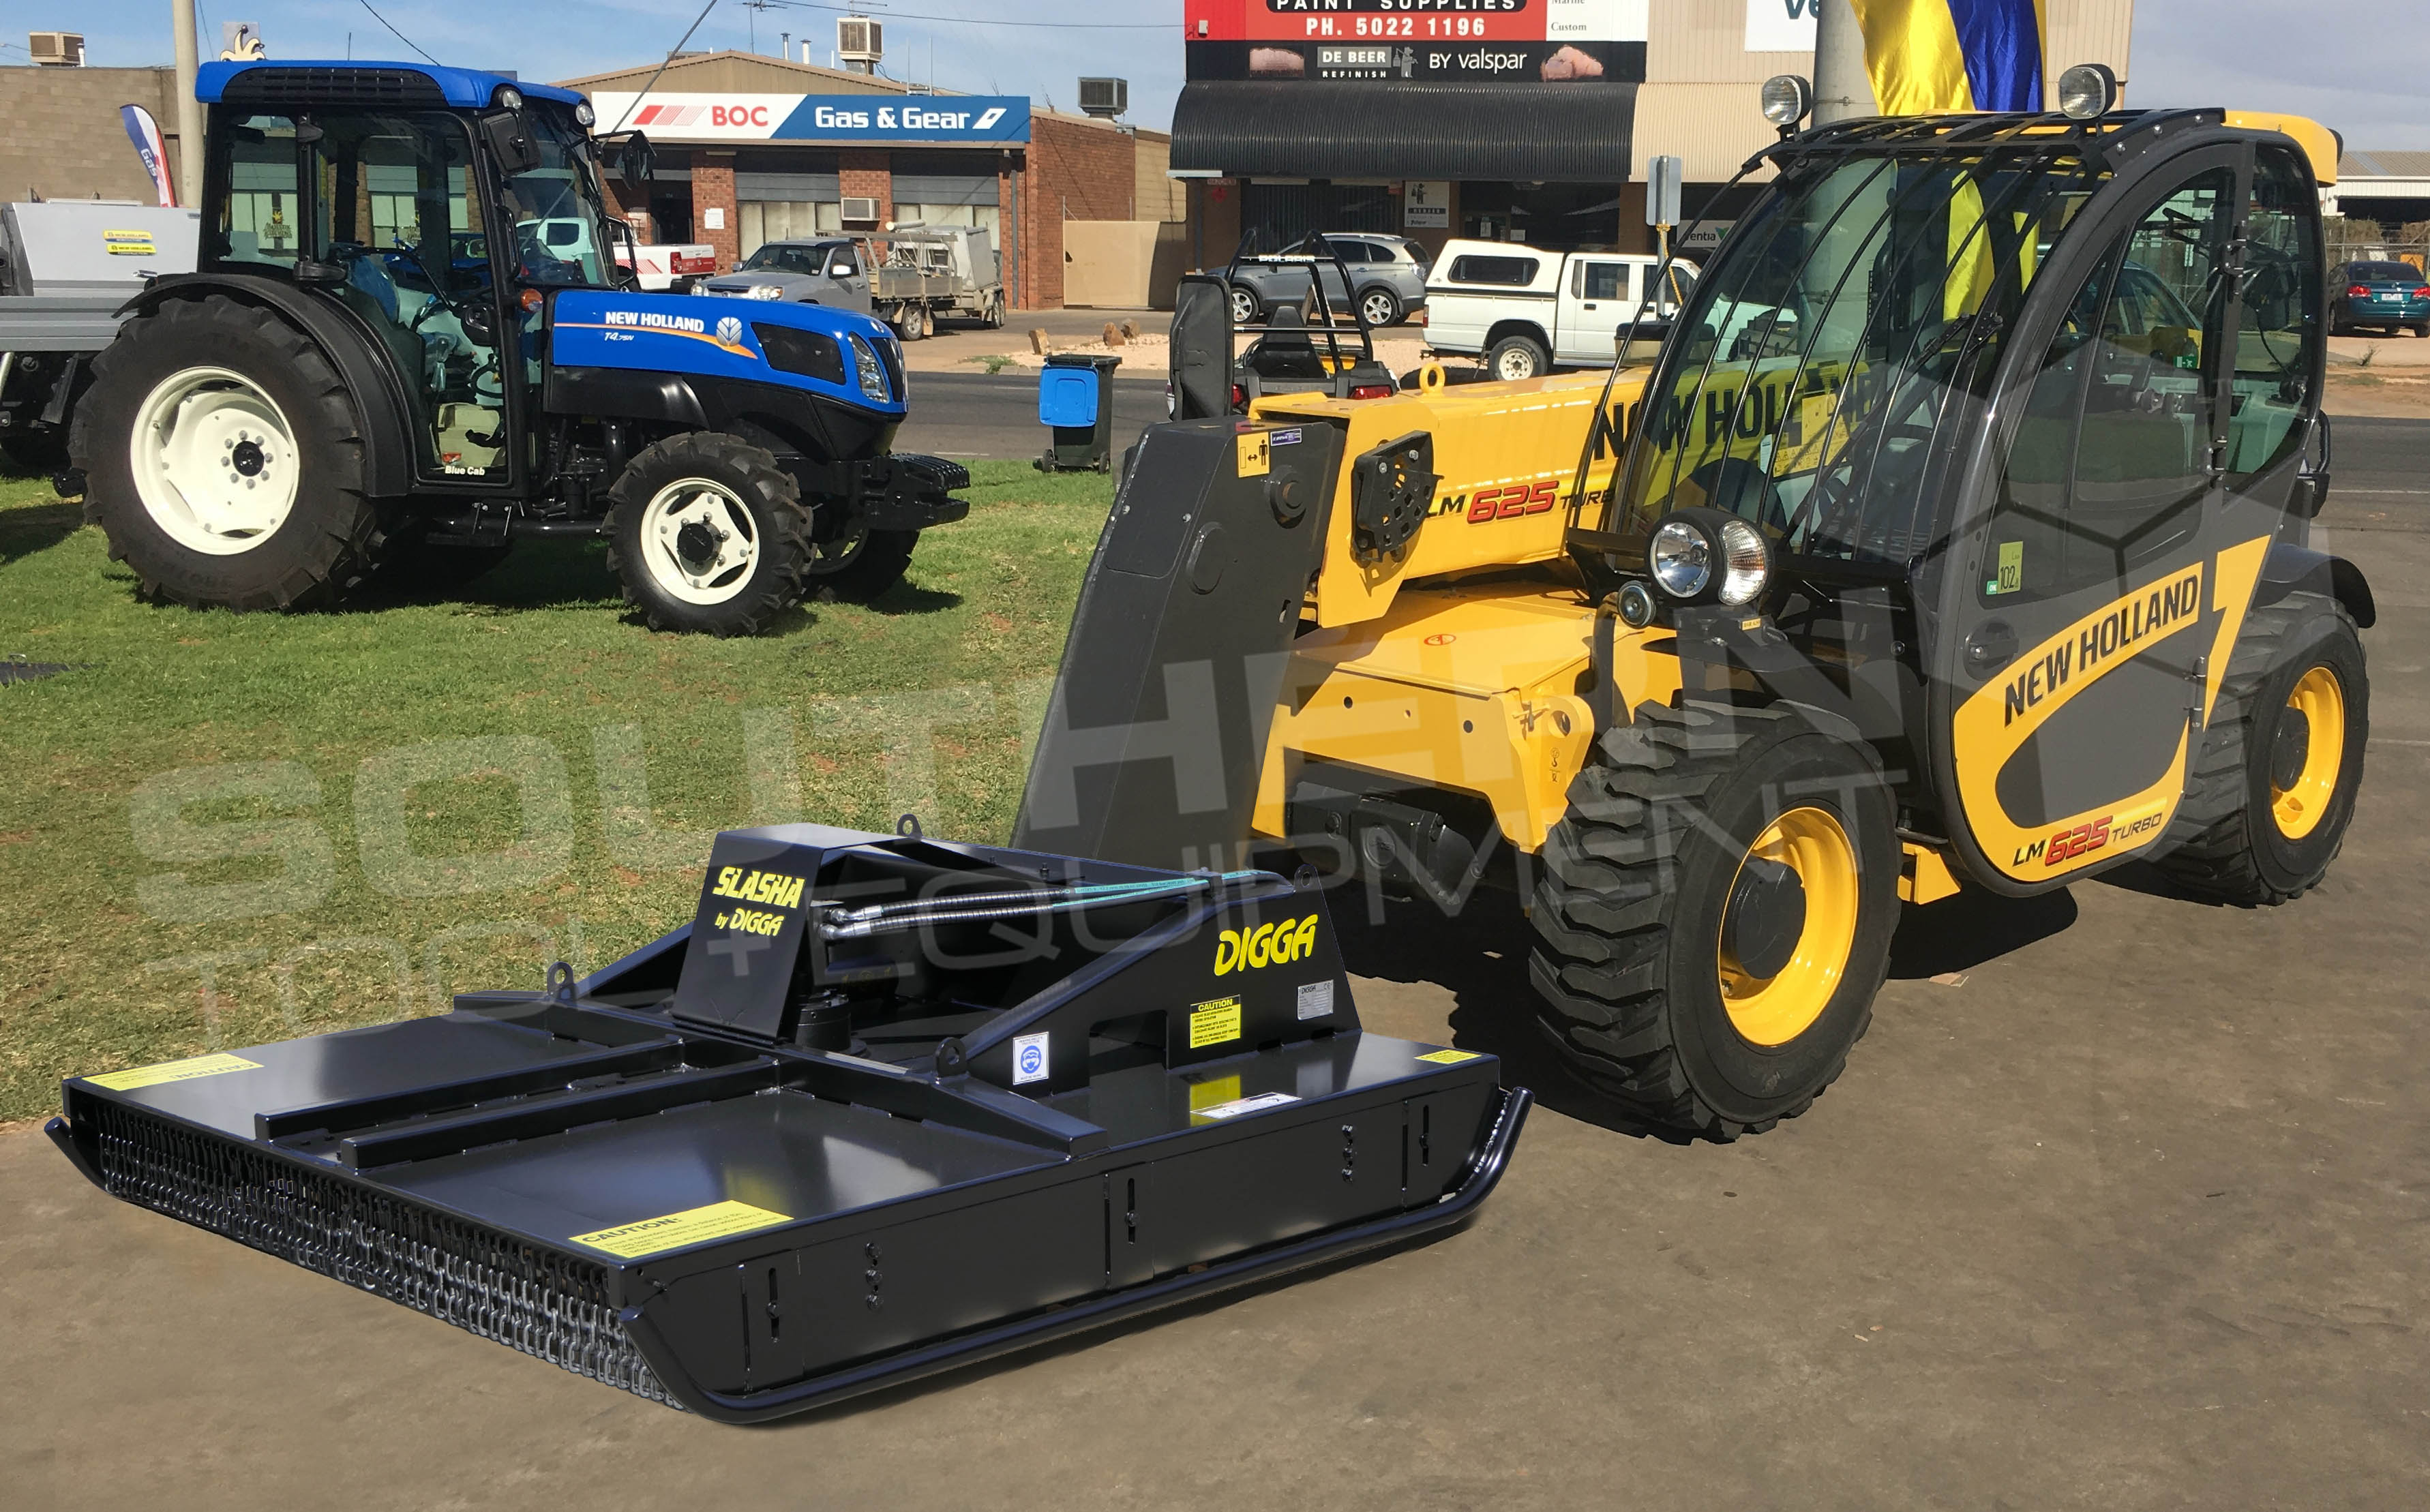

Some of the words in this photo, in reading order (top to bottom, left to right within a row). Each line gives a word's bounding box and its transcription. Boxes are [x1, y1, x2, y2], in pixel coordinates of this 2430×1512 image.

[1276, 0, 1353, 10] PAINT
[1380, 0, 1516, 10] SUPPLIES
[1306, 18, 1342, 35] PH.
[1355, 18, 1413, 35] 5022
[1427, 18, 1485, 36] 1196
[1551, 22, 1587, 31] Custom
[1323, 51, 1342, 63] DE
[1347, 51, 1386, 63] BEER
[1429, 52, 1452, 69] BY
[1458, 48, 1527, 74] valspar
[1322, 70, 1387, 78] REFINISH
[712, 106, 768, 127] BOC
[815, 106, 869, 129] Gas
[877, 107, 899, 129] &
[902, 107, 970, 130] Gear
[140, 148, 158, 177] Gas
[1690, 231, 1716, 241] entia
[605, 312, 639, 325] NEW
[641, 313, 705, 333] HOLLAND
[1593, 394, 1693, 460] NW
[1467, 480, 1560, 524] 625
[1559, 489, 1615, 510] TURB
[2000, 565, 2015, 590] 102
[2003, 638, 2073, 728] NEW
[2080, 574, 2198, 672] HOLLAND
[2012, 838, 2047, 867] LM
[2045, 815, 2114, 866] 625
[2112, 812, 2163, 843] TURBO
[712, 866, 805, 909] SLASHA
[715, 912, 729, 930] by
[729, 907, 785, 937] DIGGA
[1214, 913, 1319, 976] DIGGA
[1198, 999, 1233, 1012] CAUTION
[582, 1218, 682, 1242] CAUTION:
